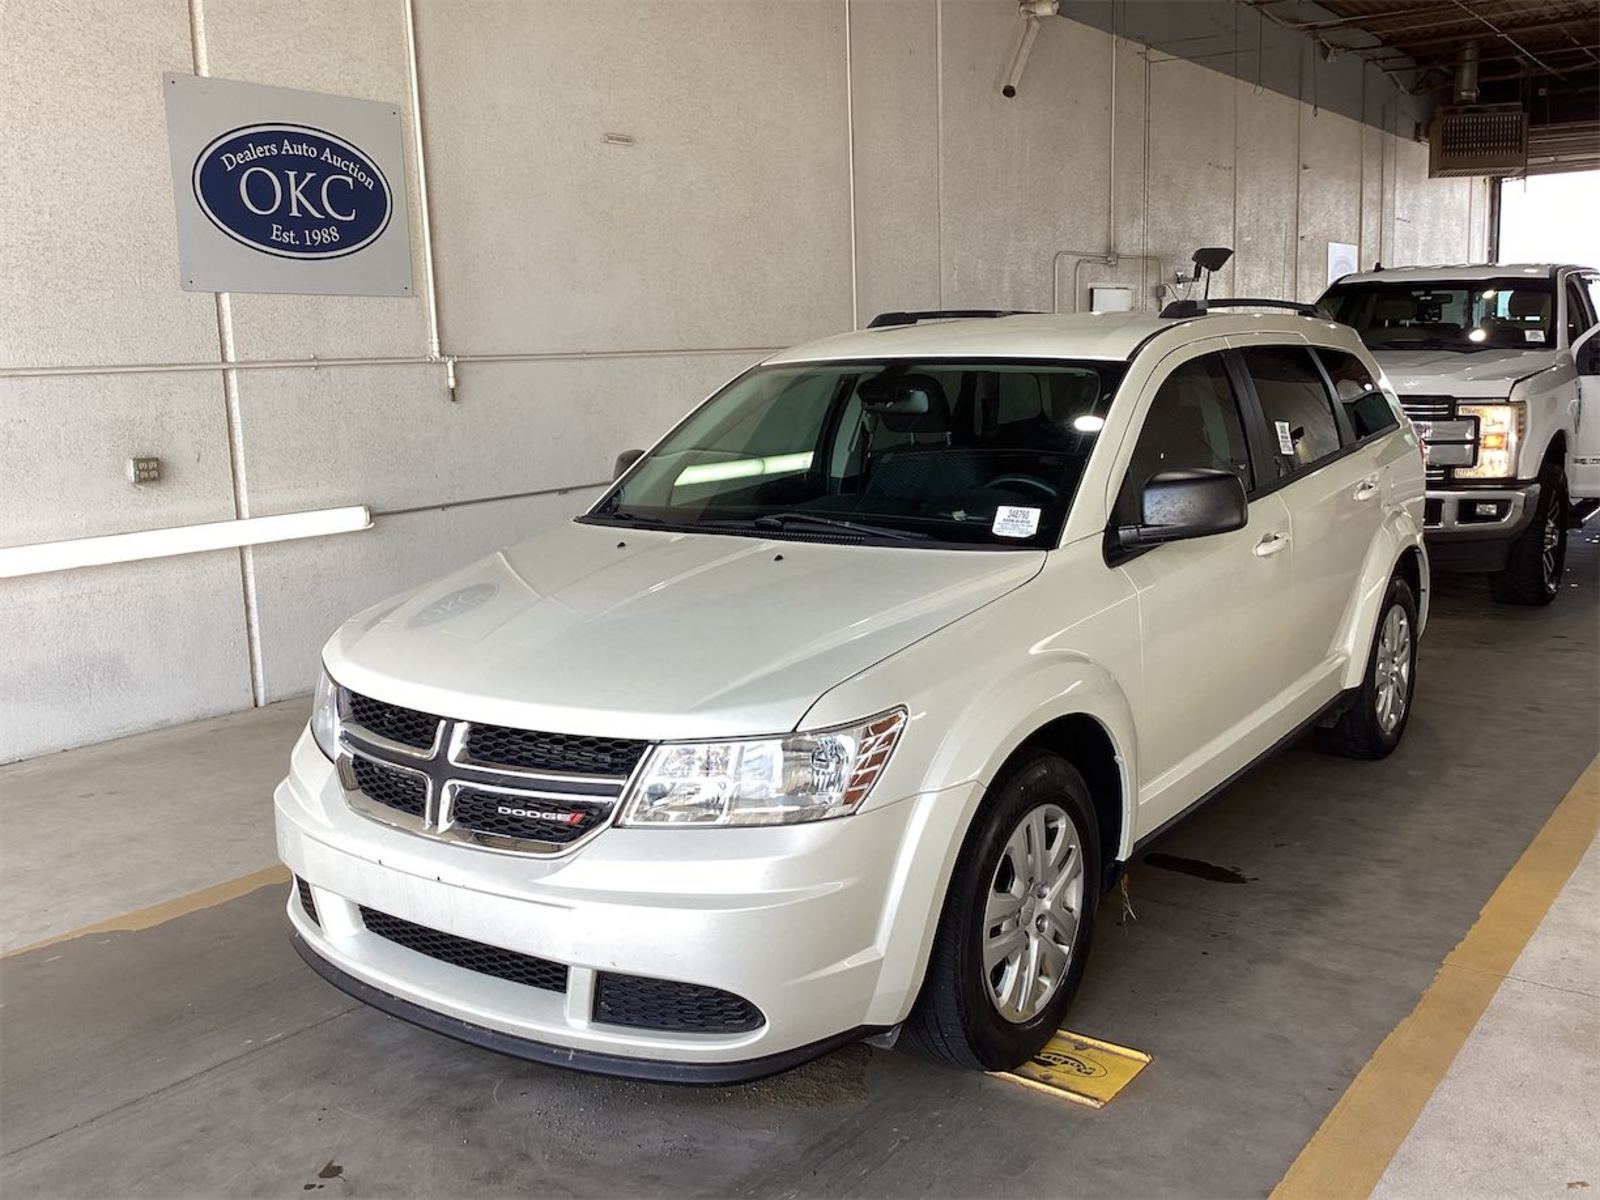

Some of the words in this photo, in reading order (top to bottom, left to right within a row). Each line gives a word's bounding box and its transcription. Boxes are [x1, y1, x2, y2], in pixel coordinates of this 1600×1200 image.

[220, 143, 278, 172] Dealers
[280, 139, 317, 159] Auto
[320, 148, 375, 191] Auction
[239, 166, 357, 221] OKC
[270, 223, 299, 245] Est.
[304, 225, 340, 246] 1988
[497, 806, 572, 823] DODGE
